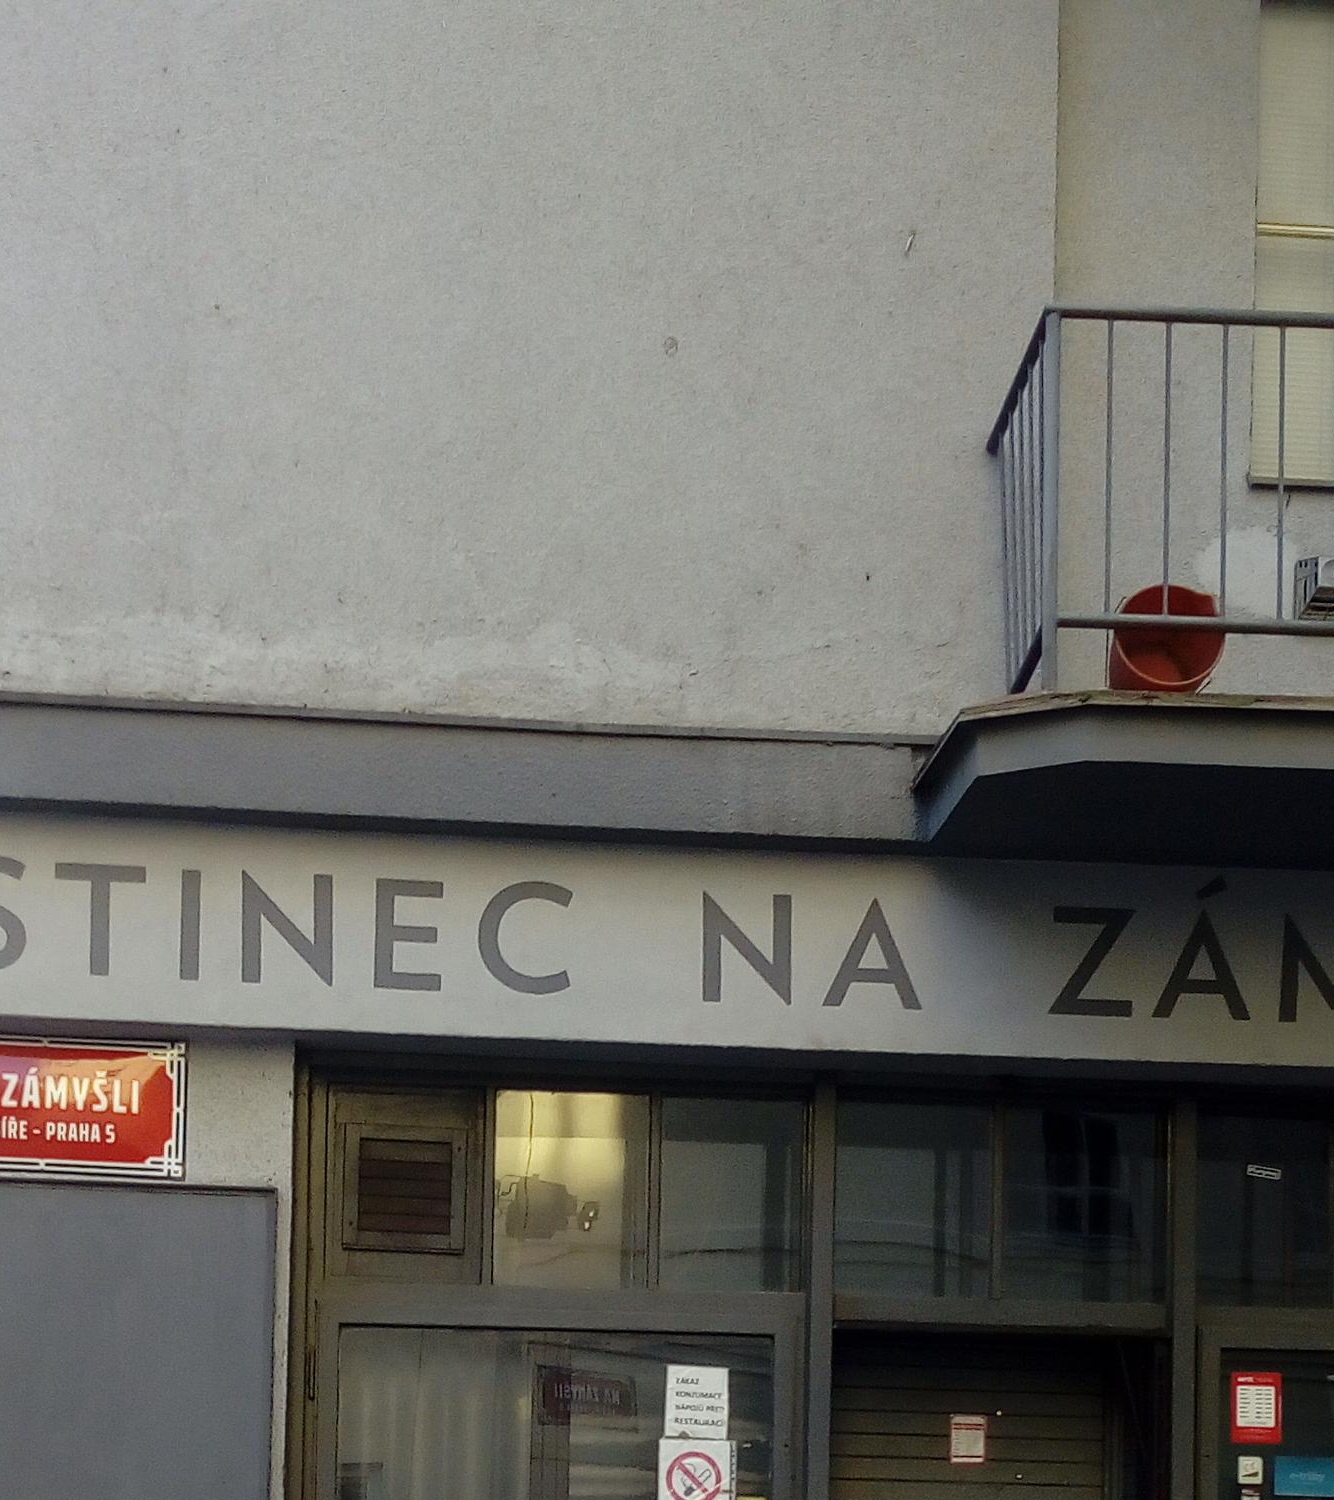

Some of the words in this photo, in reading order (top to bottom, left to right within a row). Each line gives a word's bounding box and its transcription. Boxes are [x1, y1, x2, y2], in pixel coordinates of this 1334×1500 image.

[702, 889, 923, 1011] NA
[1, 1066, 140, 1115] ZÁMYŠLI
[46, 1122, 100, 1143] PRAHA
